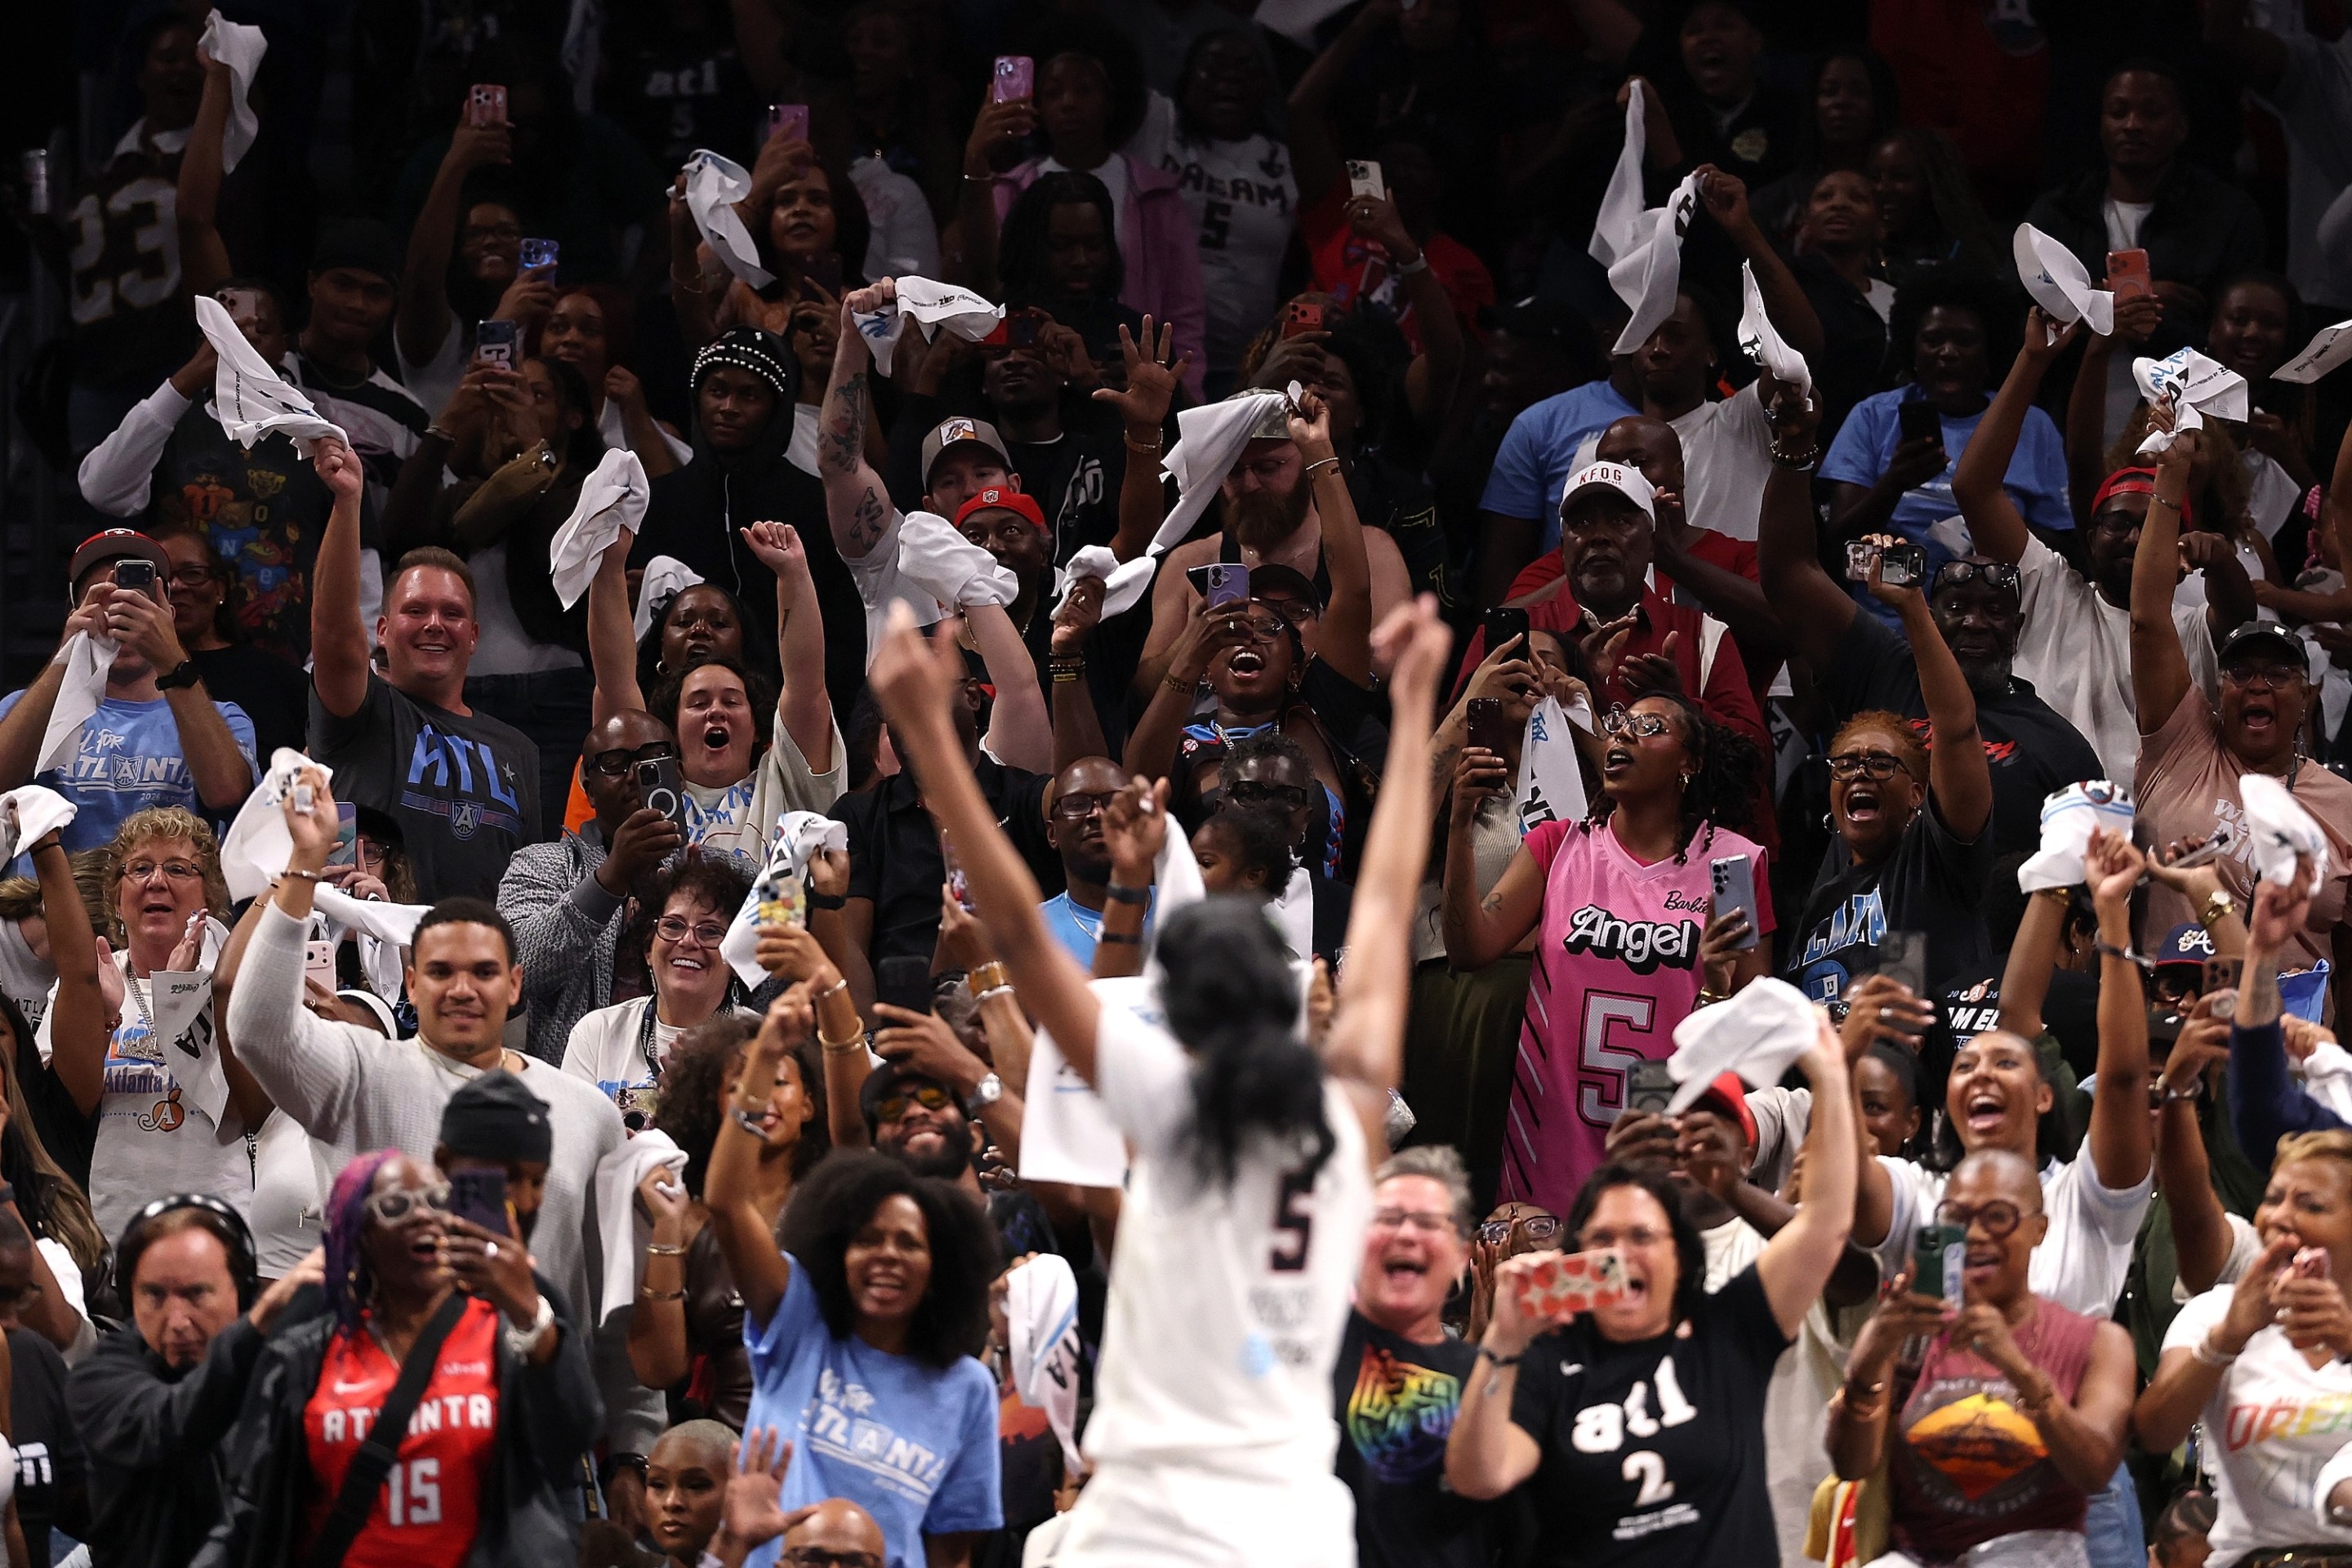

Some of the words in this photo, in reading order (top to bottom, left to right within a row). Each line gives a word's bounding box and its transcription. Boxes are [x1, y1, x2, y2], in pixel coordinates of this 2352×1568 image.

[65, 174, 184, 325] 23
[1579, 468, 1622, 484] KFOG
[408, 724, 520, 816] ATL
[1664, 890, 1708, 915] Barbie
[1564, 904, 1696, 969] Angel
[105, 1066, 163, 1094] Atlanta
[1577, 988, 1656, 1130] 5
[1272, 1166, 1313, 1271] 5
[323, 1393, 492, 1443] ATNTA
[1571, 1354, 1698, 1454] atl
[387, 1458, 442, 1526] 15
[1621, 1450, 1675, 1508] 2
